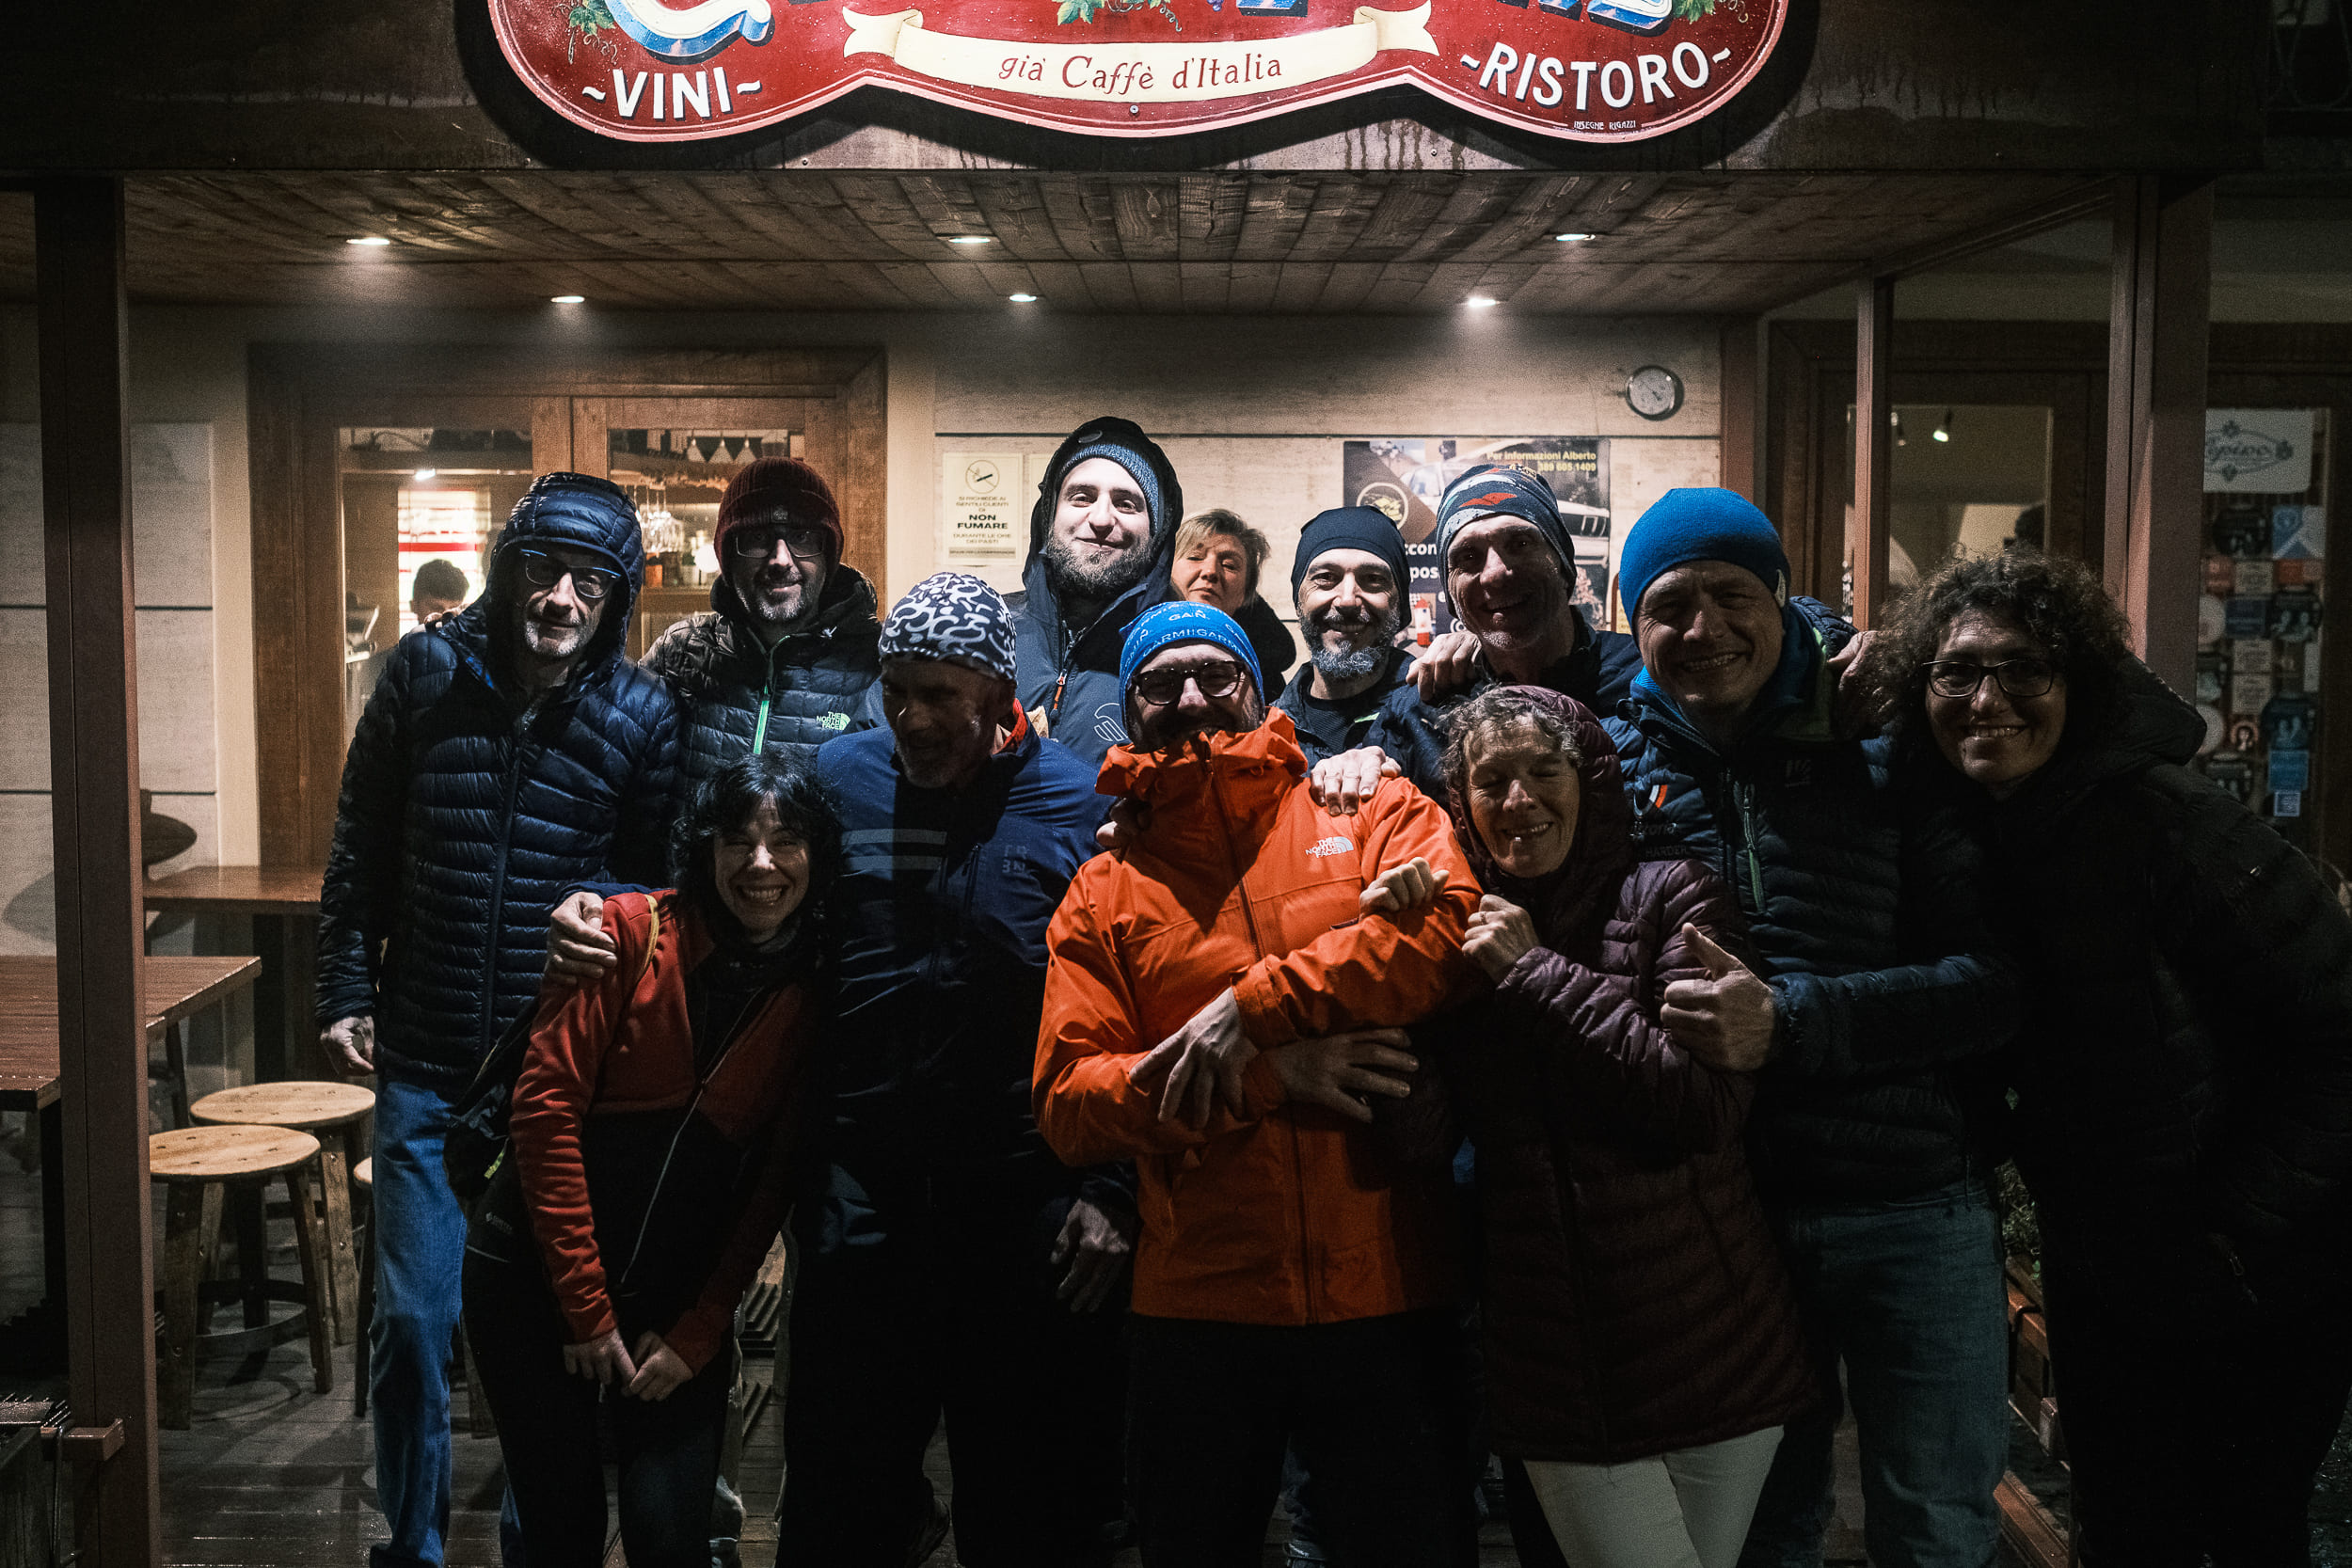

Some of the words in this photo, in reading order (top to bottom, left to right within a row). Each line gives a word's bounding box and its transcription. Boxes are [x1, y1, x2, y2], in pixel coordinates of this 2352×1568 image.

[998, 55, 1046, 81] già
[1061, 55, 1154, 95] Caffè
[1172, 53, 1283, 89] d'Italia
[1573, 120, 1604, 130] INSEGNE
[1609, 120, 1636, 130] RIGAZZI
[1486, 451, 1502, 460] Per
[1563, 451, 1597, 460] Alberto
[1575, 462, 1597, 471] 1409
[816, 715, 840, 724] NORTH
[821, 721, 840, 730] FACE
[1317, 837, 1333, 847] THE
[1305, 841, 1335, 855] NORTH
[1315, 848, 1339, 858] FACE
